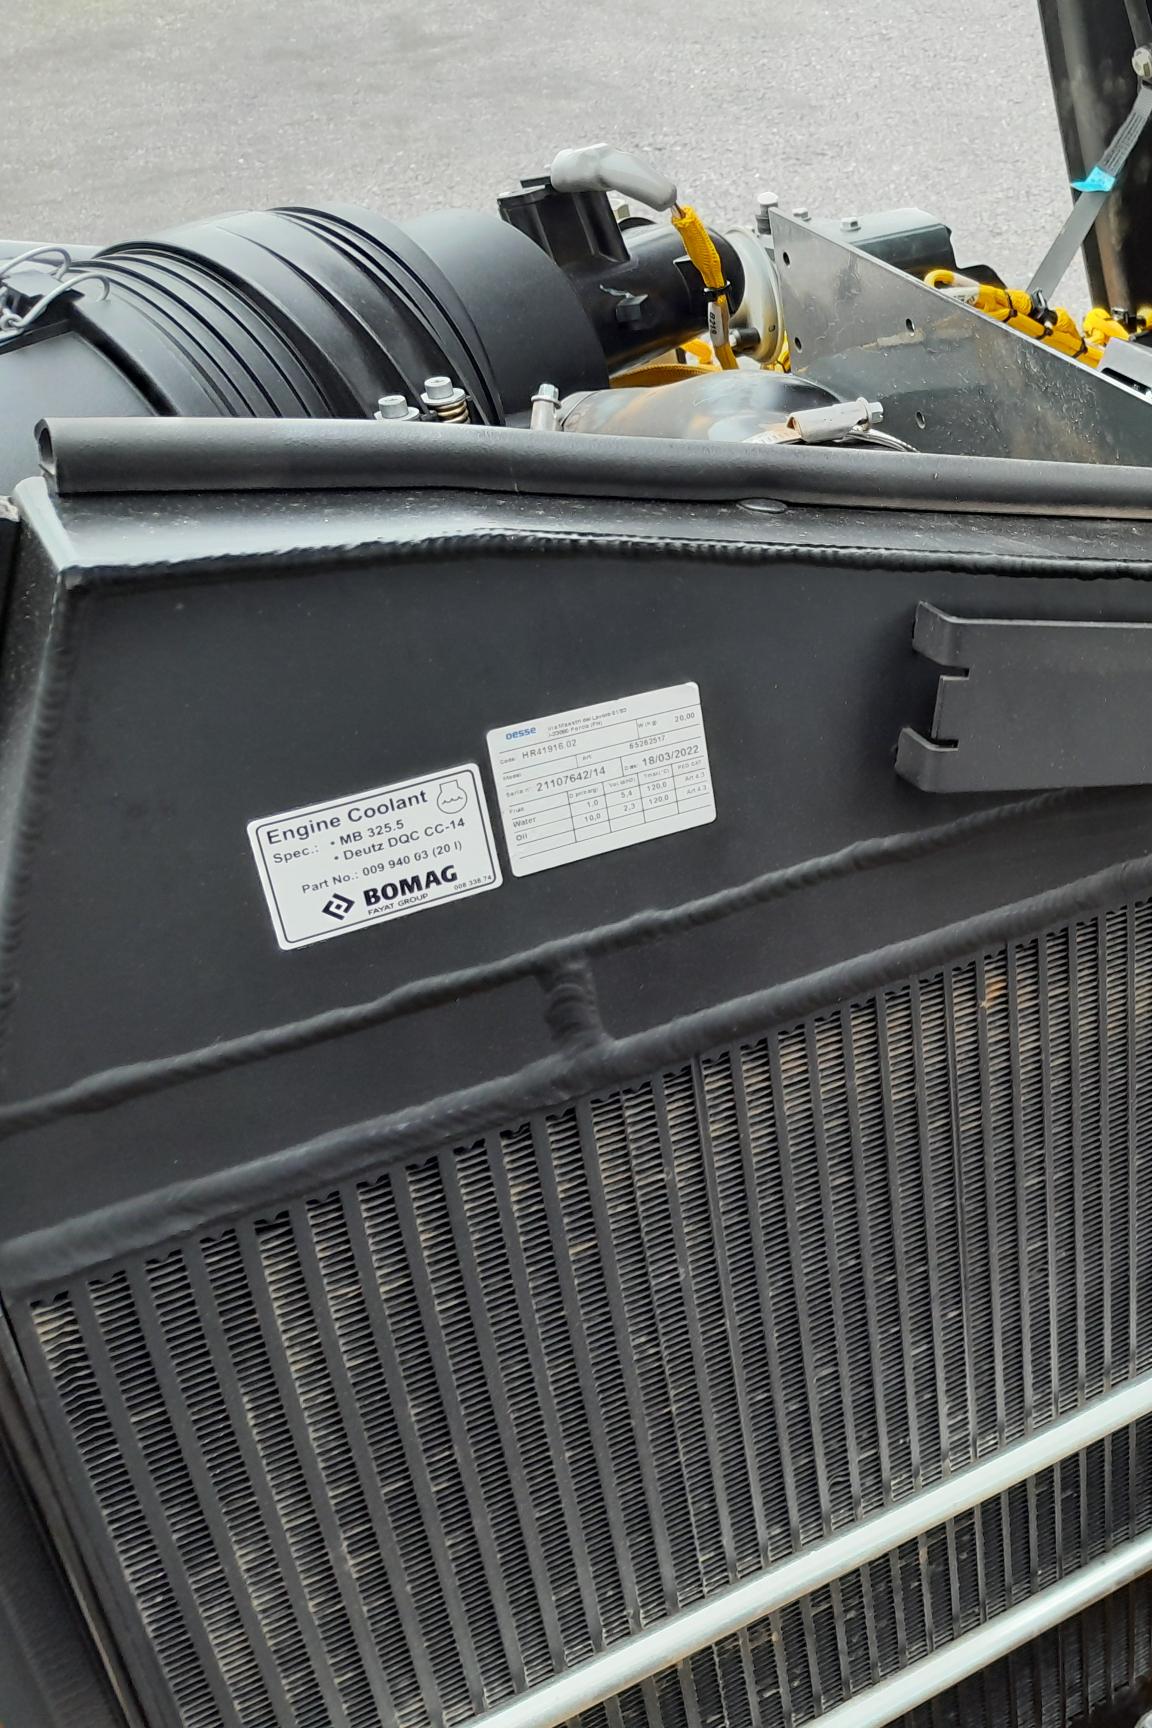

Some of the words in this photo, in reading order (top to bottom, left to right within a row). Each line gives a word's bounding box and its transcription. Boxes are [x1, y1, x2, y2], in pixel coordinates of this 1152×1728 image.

[505, 726, 537, 741] oesse
[642, 744, 700, 767] 18/03/2022
[536, 765, 606, 793] 21107642/14
[266, 816, 341, 845] Engine
[347, 789, 428, 823] Coolant
[512, 816, 537, 828] Water
[272, 844, 319, 865] Spec.:
[339, 830, 363, 846] MB
[367, 818, 405, 838] 325.5
[343, 841, 385, 861] Deutz
[387, 829, 420, 848] DQC
[424, 816, 466, 837] CC-14
[301, 879, 330, 894] Part
[332, 871, 359, 885] No.:
[362, 862, 385, 877] 009
[388, 854, 410, 870] 940
[414, 849, 429, 862] 03
[431, 842, 451, 858] (20
[362, 863, 459, 907] BOMAG
[367, 902, 395, 916] FAYAT
[397, 892, 429, 907] GROUP
